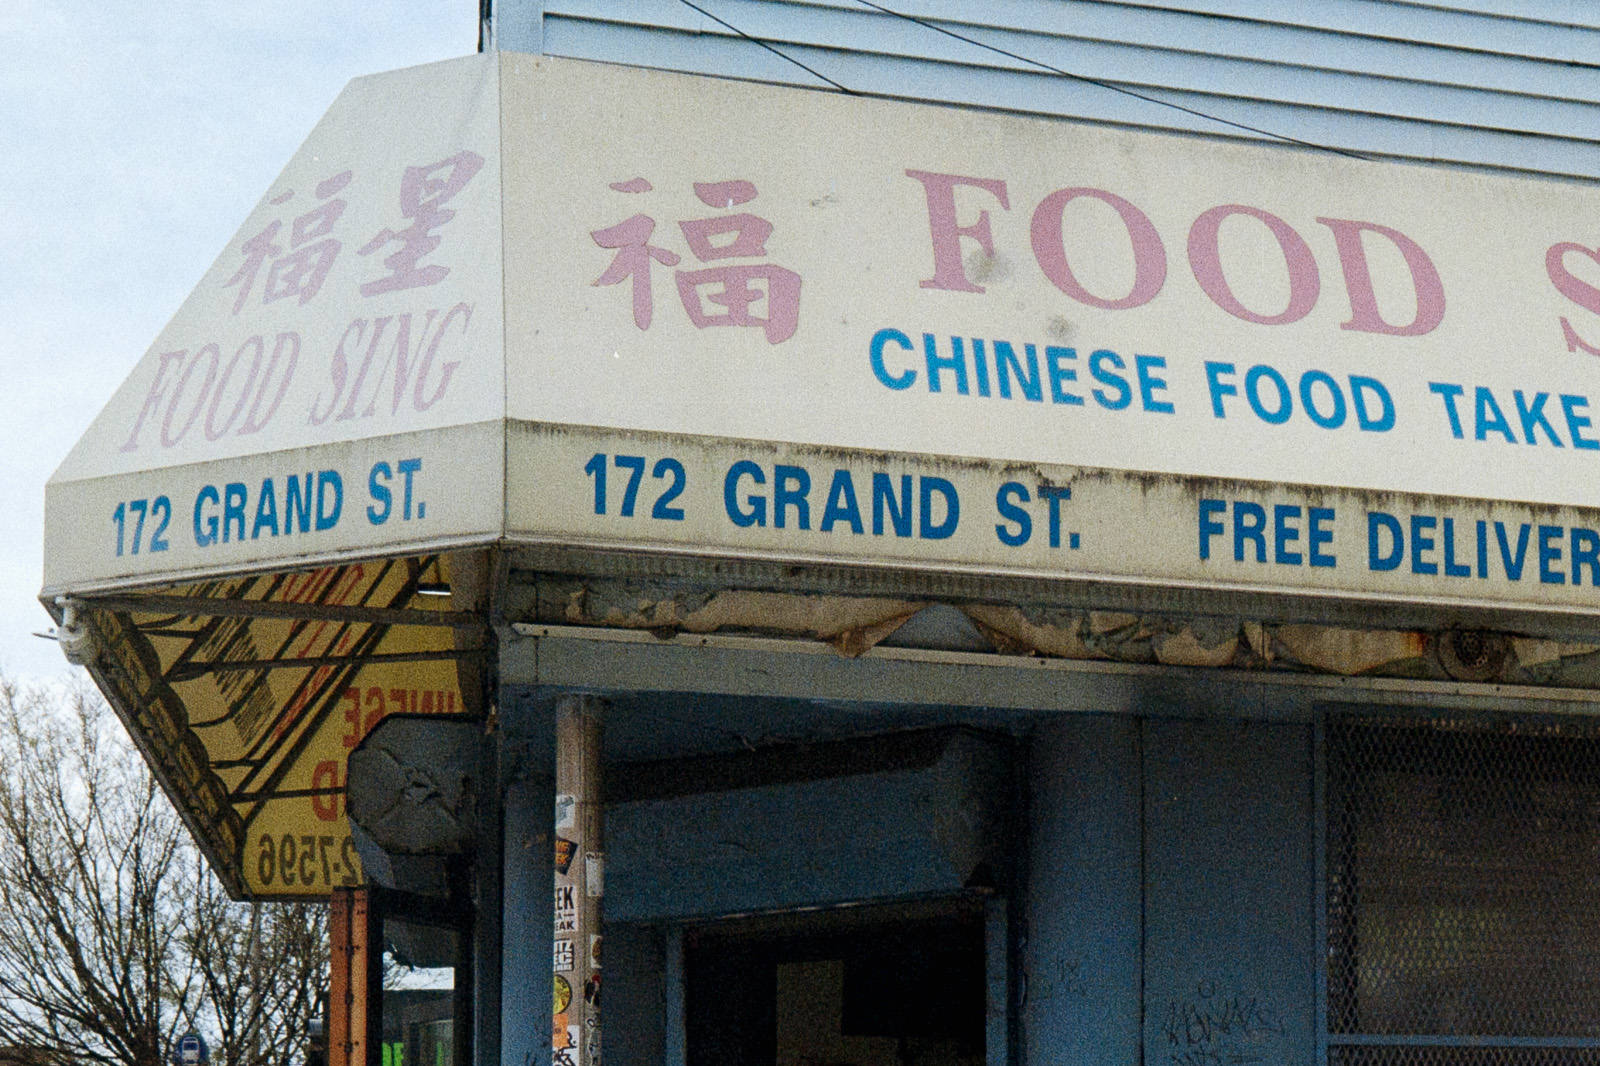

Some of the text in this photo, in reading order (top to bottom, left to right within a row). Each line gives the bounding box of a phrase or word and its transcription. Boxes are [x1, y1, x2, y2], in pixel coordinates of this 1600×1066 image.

[590, 177, 803, 345] 福
[905, 168, 1447, 338] FOOD
[120, 302, 475, 453] FOOD SING
[868, 326, 1177, 416] CHINESE
[1202, 359, 1398, 434] FOOD
[111, 457, 428, 557] 172 GRAND ST.
[583, 452, 1082, 551] 172 GRAND ST.
[1197, 498, 1338, 569] FREE
